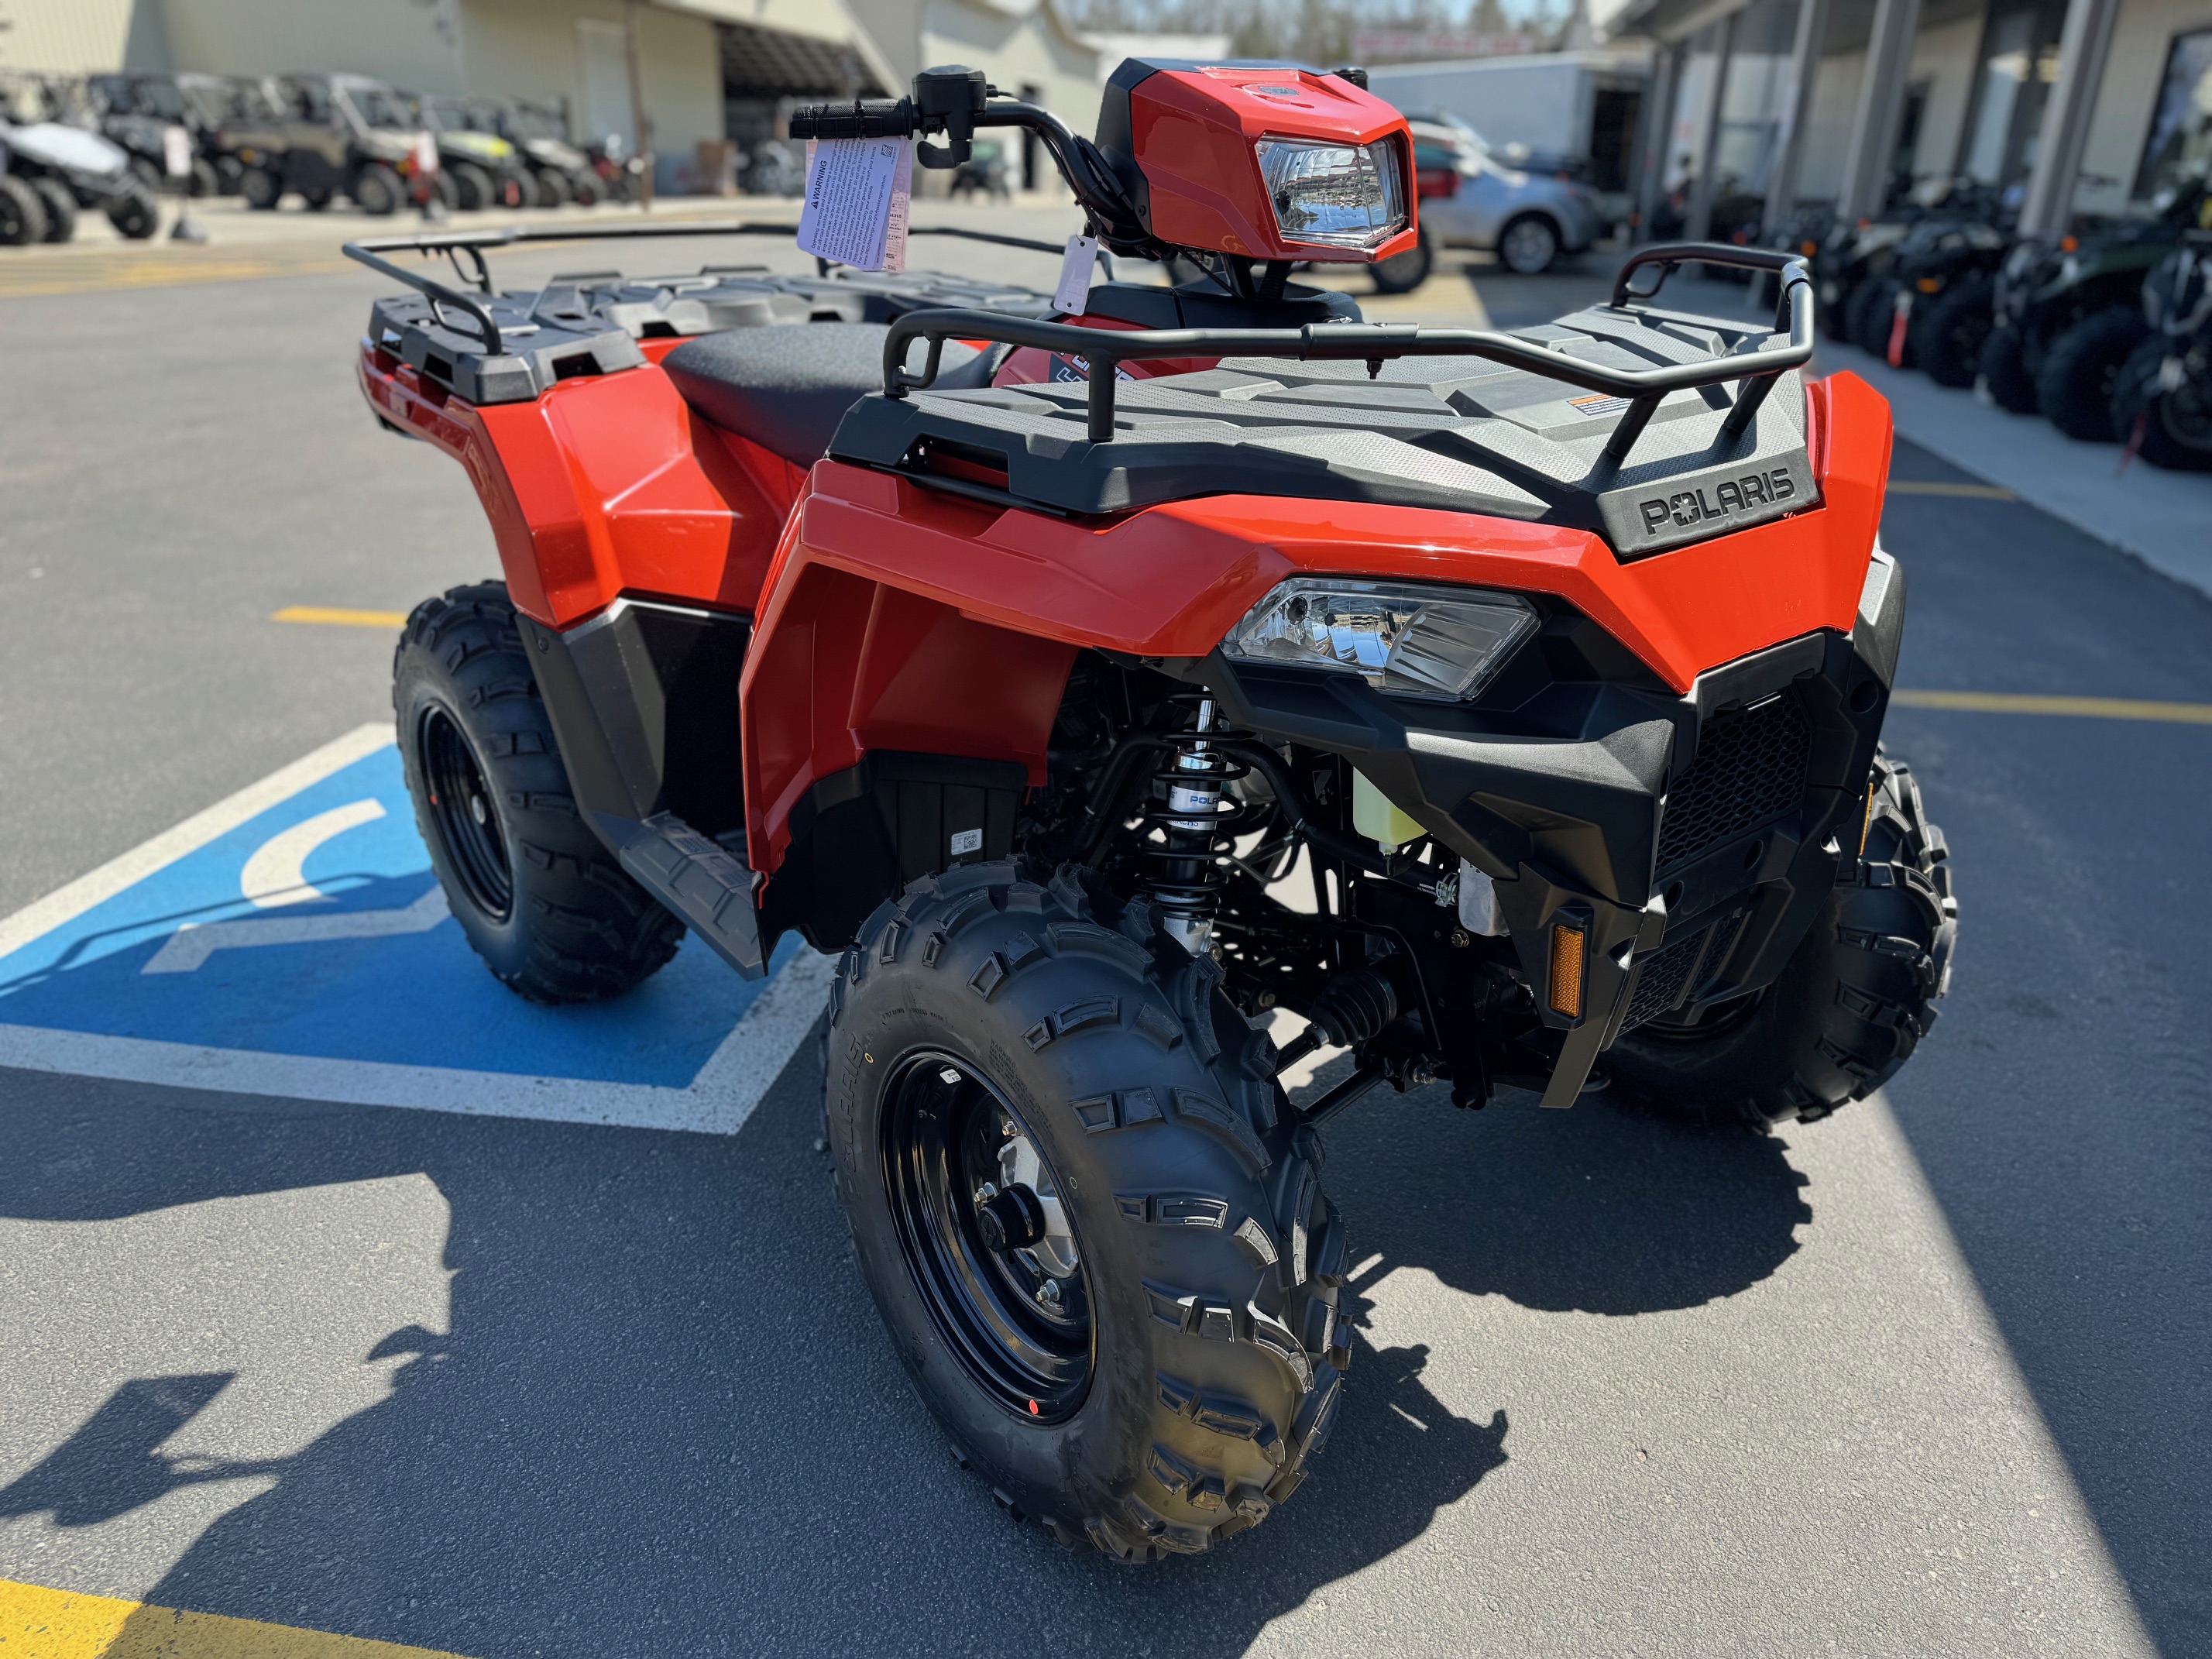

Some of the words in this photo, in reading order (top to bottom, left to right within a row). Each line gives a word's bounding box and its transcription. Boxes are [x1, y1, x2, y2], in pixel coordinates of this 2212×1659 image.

[812, 160, 826, 201] WARNING
[823, 175, 831, 198] maintaining
[843, 178, 853, 204] reproductive
[847, 231, 857, 260] well-ventilated
[861, 221, 870, 244] information
[1639, 468, 1795, 537] POLARIS
[1190, 795, 1220, 805] POLA
[838, 1032, 865, 1201] POLARIS
